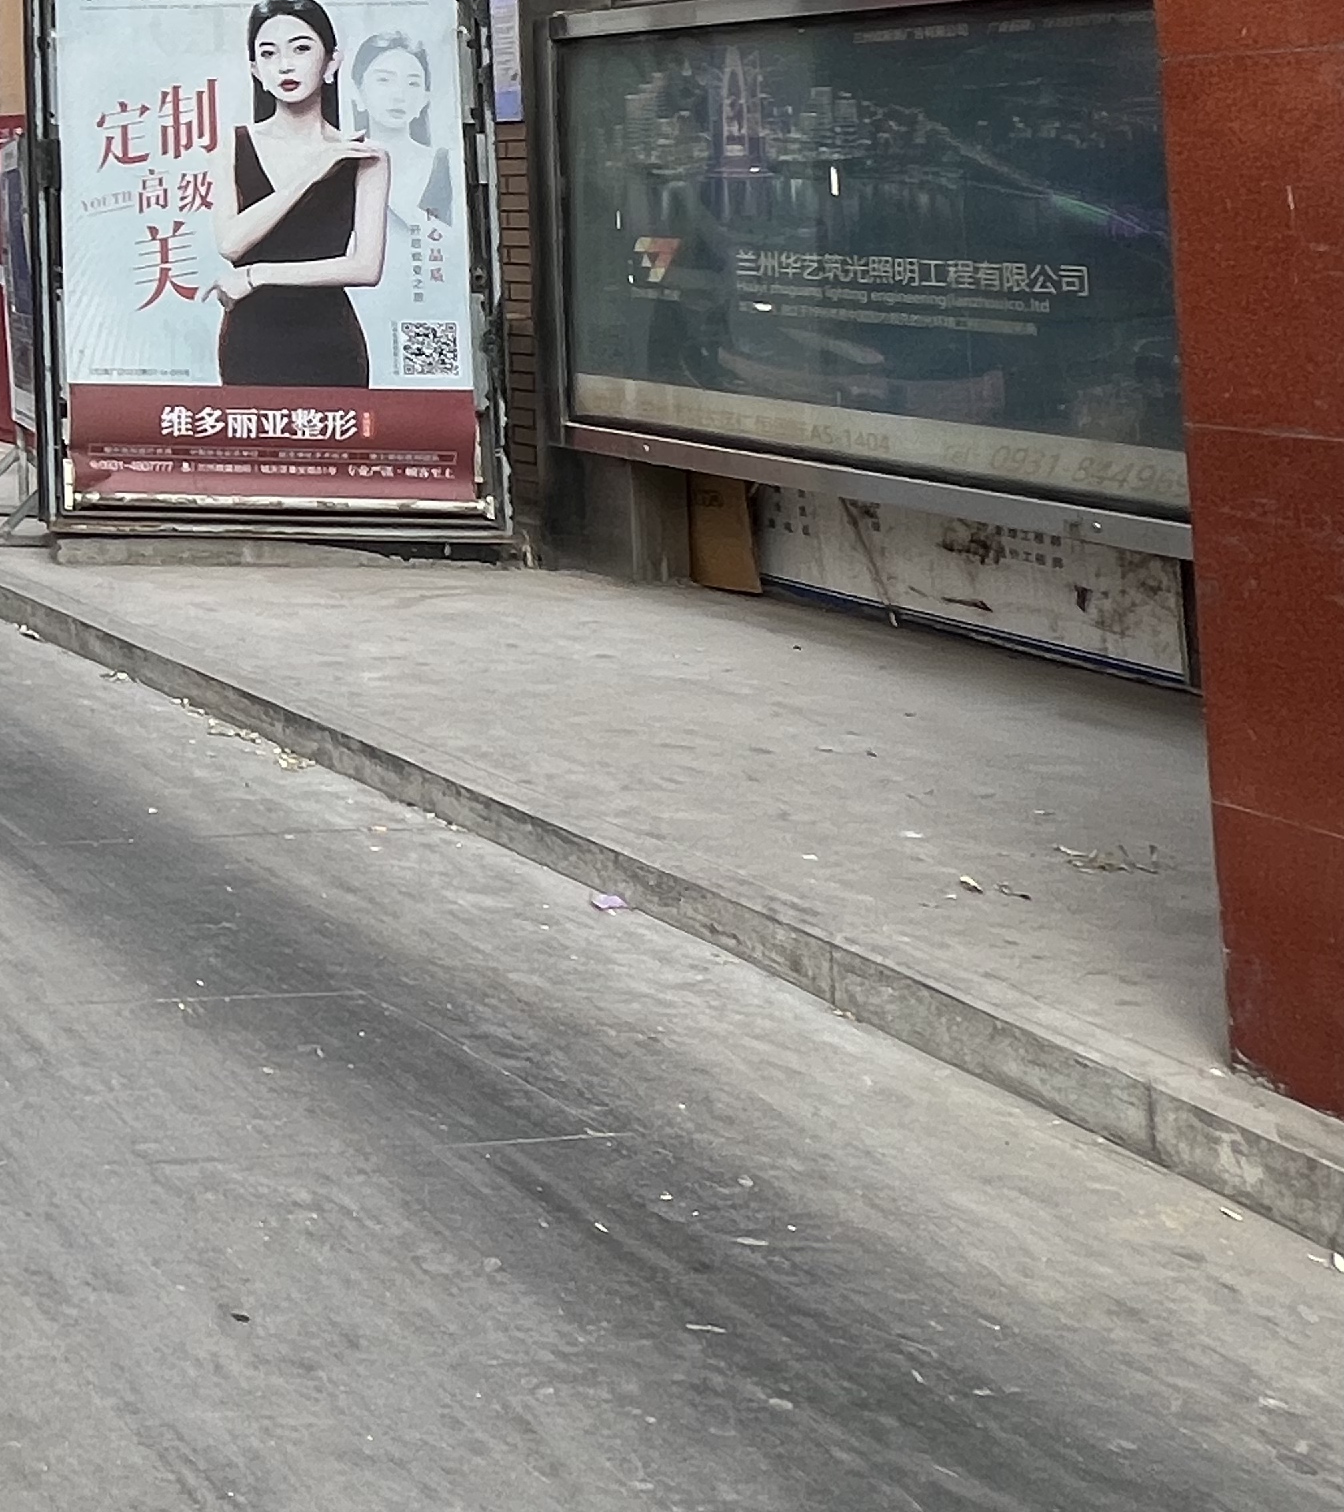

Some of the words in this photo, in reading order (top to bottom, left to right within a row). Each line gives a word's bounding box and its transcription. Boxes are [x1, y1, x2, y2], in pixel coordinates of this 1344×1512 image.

[96, 78, 219, 173] 定制
[136, 169, 215, 216] 高级
[133, 218, 200, 313] 美
[160, 406, 358, 442] 维多丽亚整形
